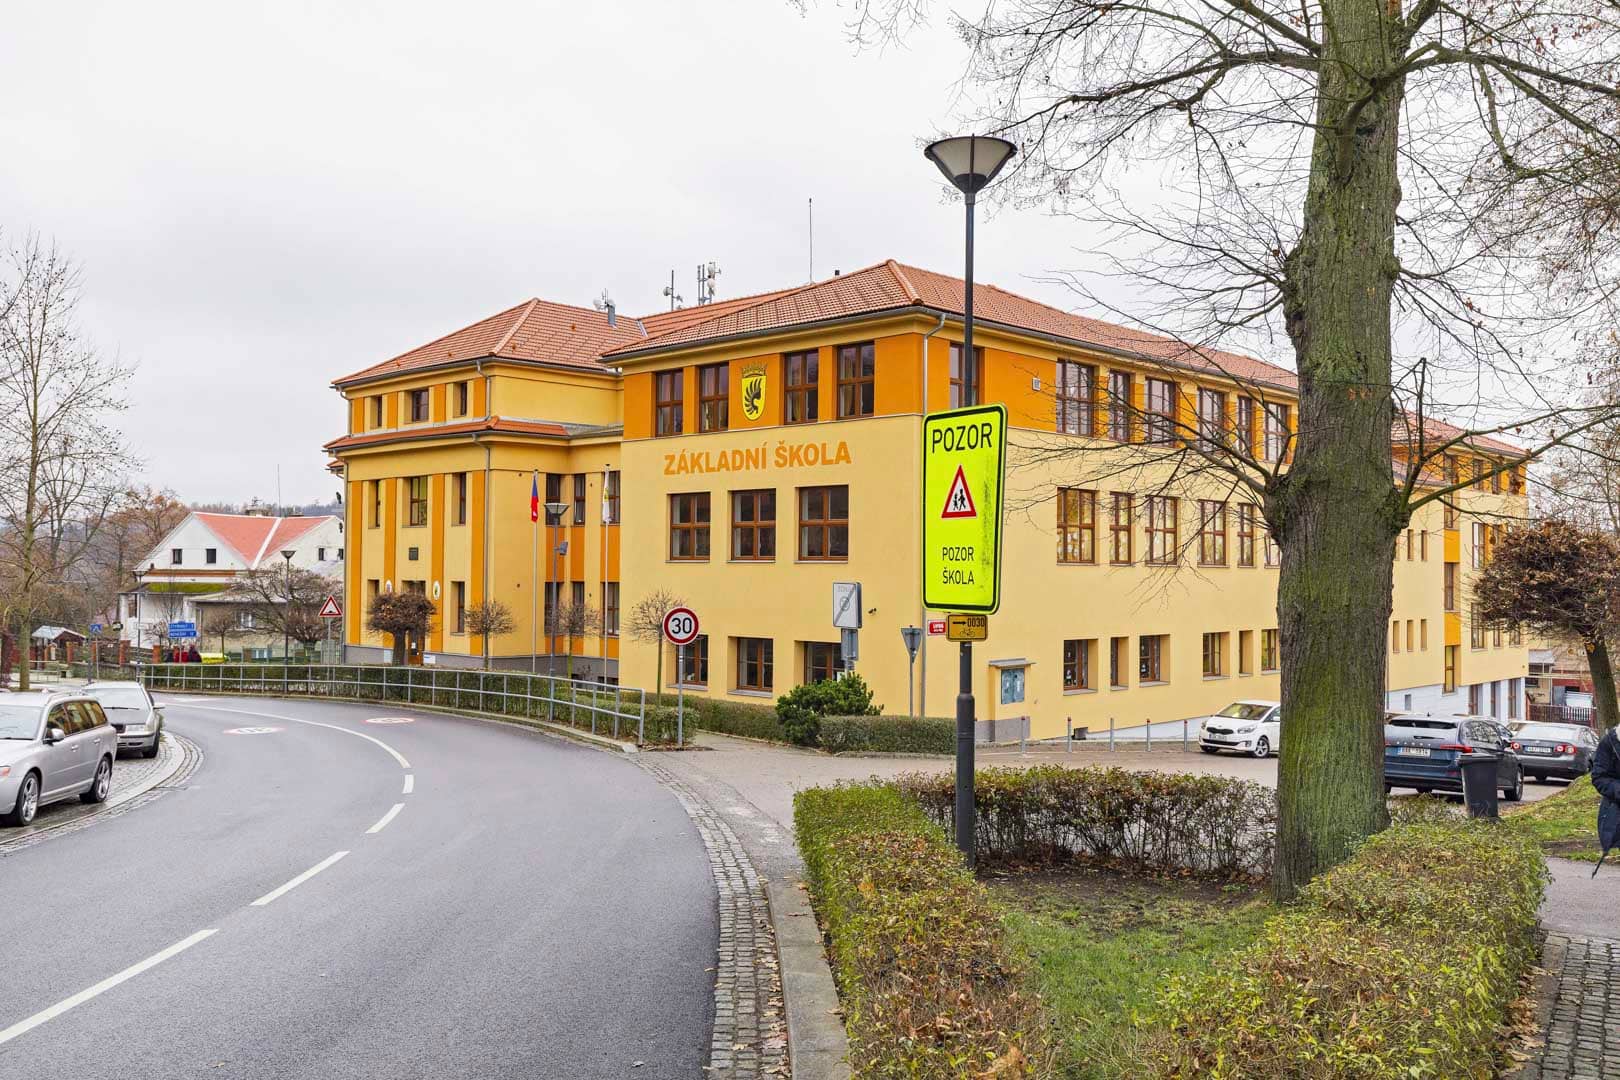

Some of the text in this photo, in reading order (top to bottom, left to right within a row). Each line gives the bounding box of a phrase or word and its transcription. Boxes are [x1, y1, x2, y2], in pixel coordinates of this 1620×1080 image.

[932, 422, 993, 454] POZOR
[663, 440, 852, 476] ZÁKLADNÍ ŠKOLA
[942, 546, 975, 562] POZOR
[942, 566, 975, 585] ŠKOLA
[671, 617, 692, 634] 30
[967, 617, 985, 628] 0030
